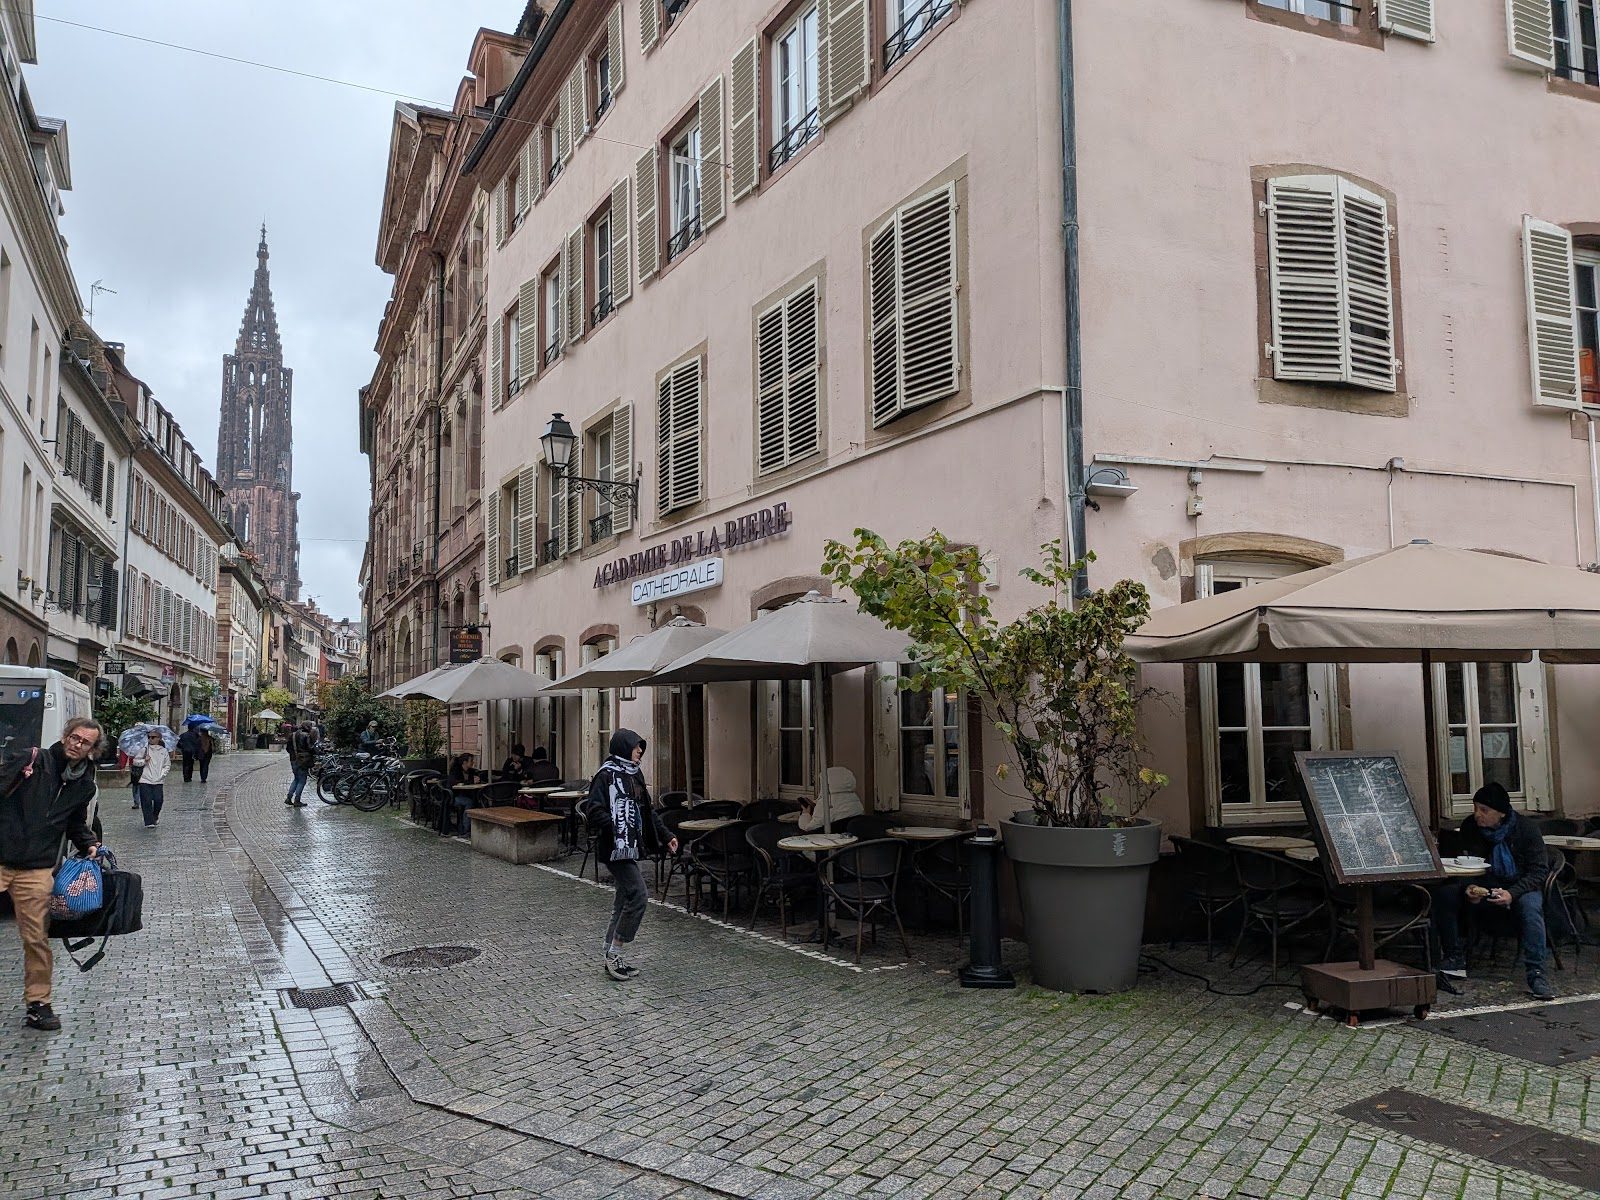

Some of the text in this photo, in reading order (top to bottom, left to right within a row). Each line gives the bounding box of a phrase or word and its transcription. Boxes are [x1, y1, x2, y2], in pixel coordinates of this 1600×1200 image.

[593, 502, 788, 589] ACADEMIE DE LA BIERE
[633, 562, 715, 602] CATHEDRALE
